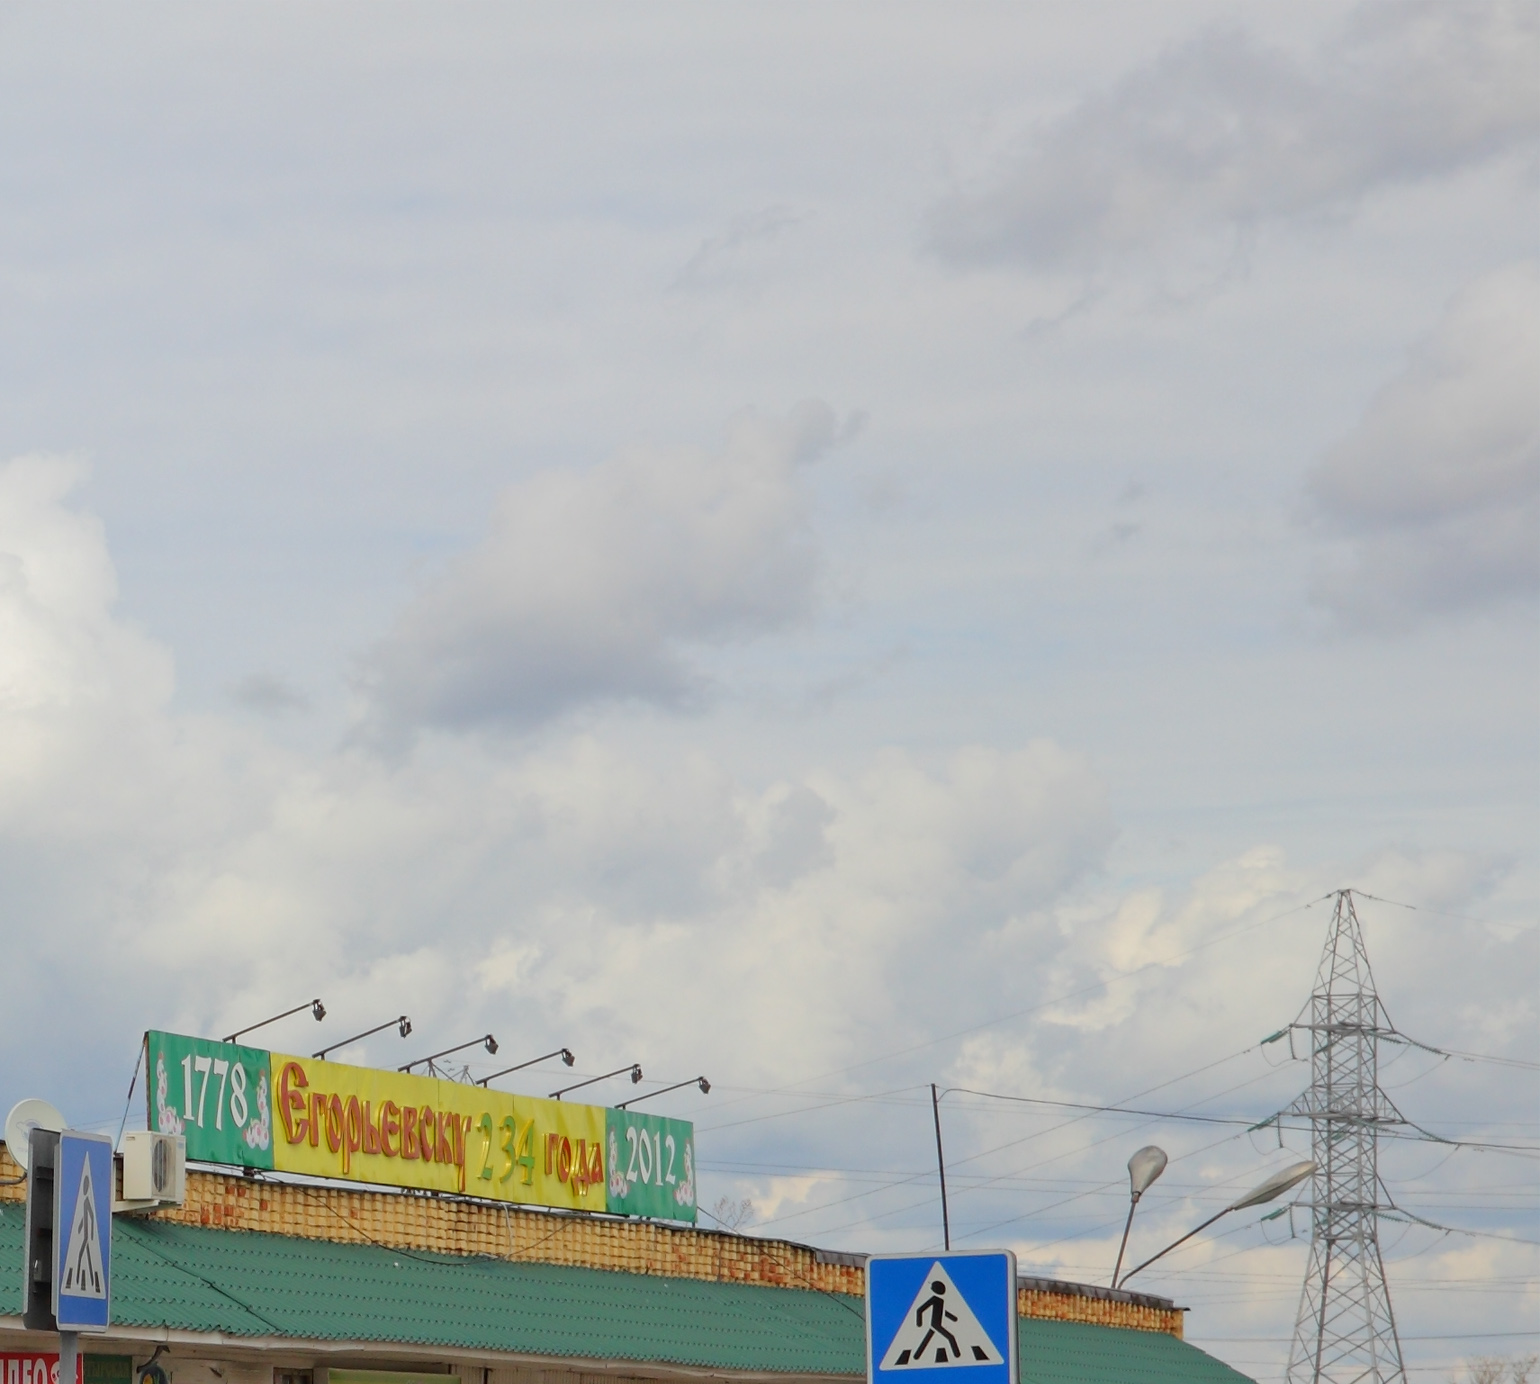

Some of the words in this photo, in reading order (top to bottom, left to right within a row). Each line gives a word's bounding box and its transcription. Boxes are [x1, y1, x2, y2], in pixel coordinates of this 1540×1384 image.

[181, 1054, 249, 1131] 1778
[475, 1112, 536, 1187] 234
[543, 1131, 605, 1197] года
[626, 1125, 677, 1186] 2012
